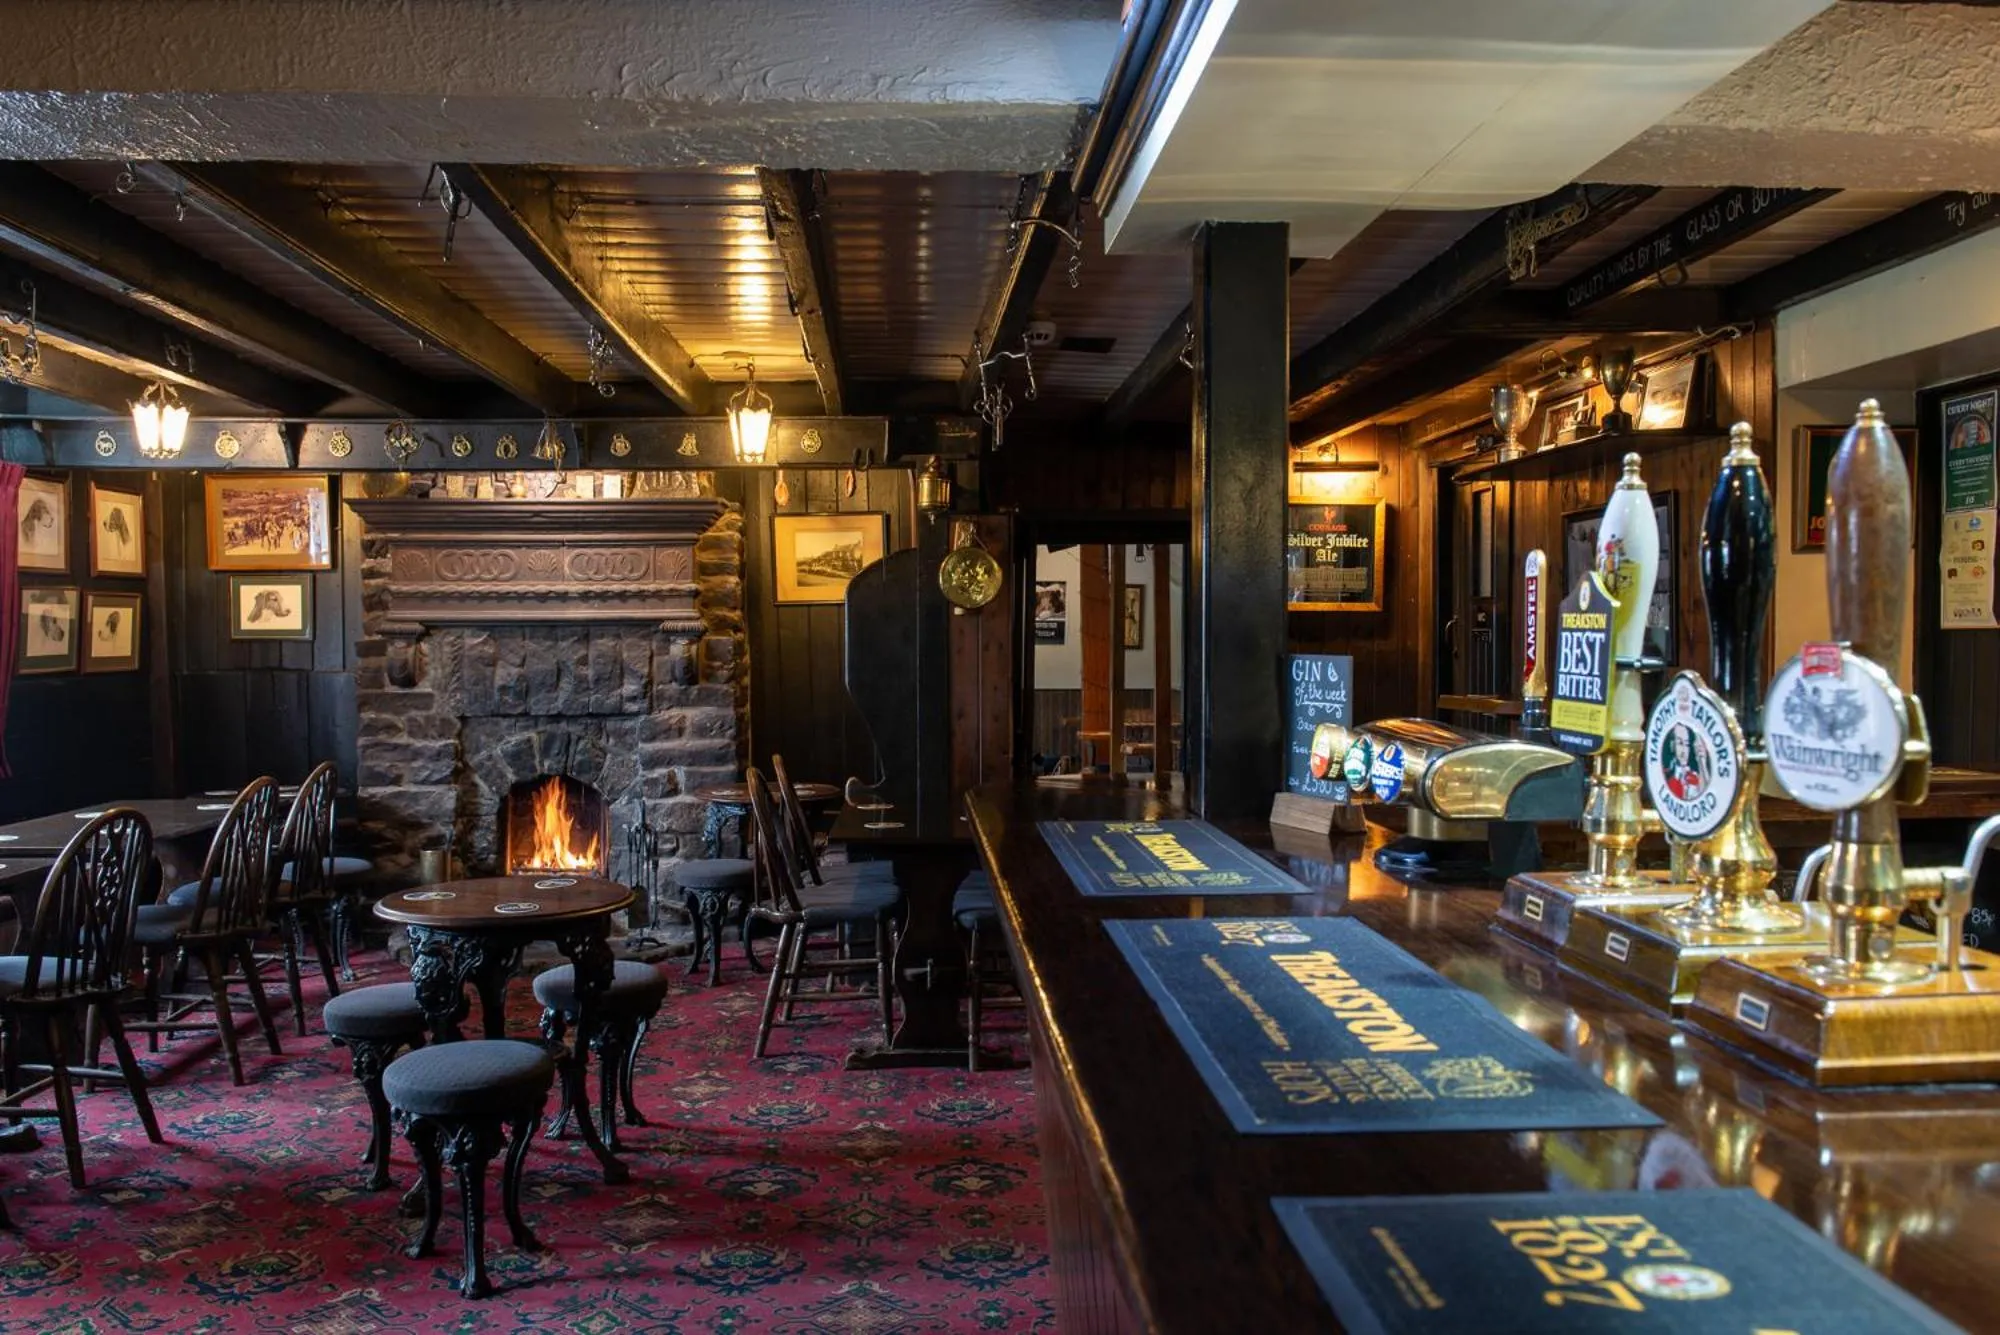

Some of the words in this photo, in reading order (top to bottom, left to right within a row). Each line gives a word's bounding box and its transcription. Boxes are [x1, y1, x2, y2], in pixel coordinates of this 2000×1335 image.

[1567, 271, 1604, 307] QUALITY
[1606, 252, 1635, 283] WINES
[1637, 243, 1651, 270] BY
[1652, 233, 1673, 260] THE
[1686, 204, 1721, 241] GLASS
[1725, 193, 1745, 222] OR
[1288, 533, 1323, 547] Silver
[1326, 533, 1369, 549] Jubilee
[1315, 549, 1338, 563] Ale
[1527, 578, 1537, 660] AMSTEL
[1562, 613, 1607, 630] THEAKSTON
[1292, 659, 1322, 682] GIN
[1559, 631, 1606, 676] BEST
[1308, 682, 1323, 700] the
[1325, 681, 1348, 702] week
[1557, 674, 1603, 701] BITTER
[1650, 698, 1677, 765] TIMOTHY
[1691, 699, 1731, 779] TAYLOR'S
[1771, 733, 1884, 783] Wainwright
[1659, 784, 1717, 824] LANDLORD
[1270, 951, 1440, 1052] THEAKSTON
[1261, 1061, 1340, 1104] HOPS
[1490, 1217, 1646, 1312] 1827
